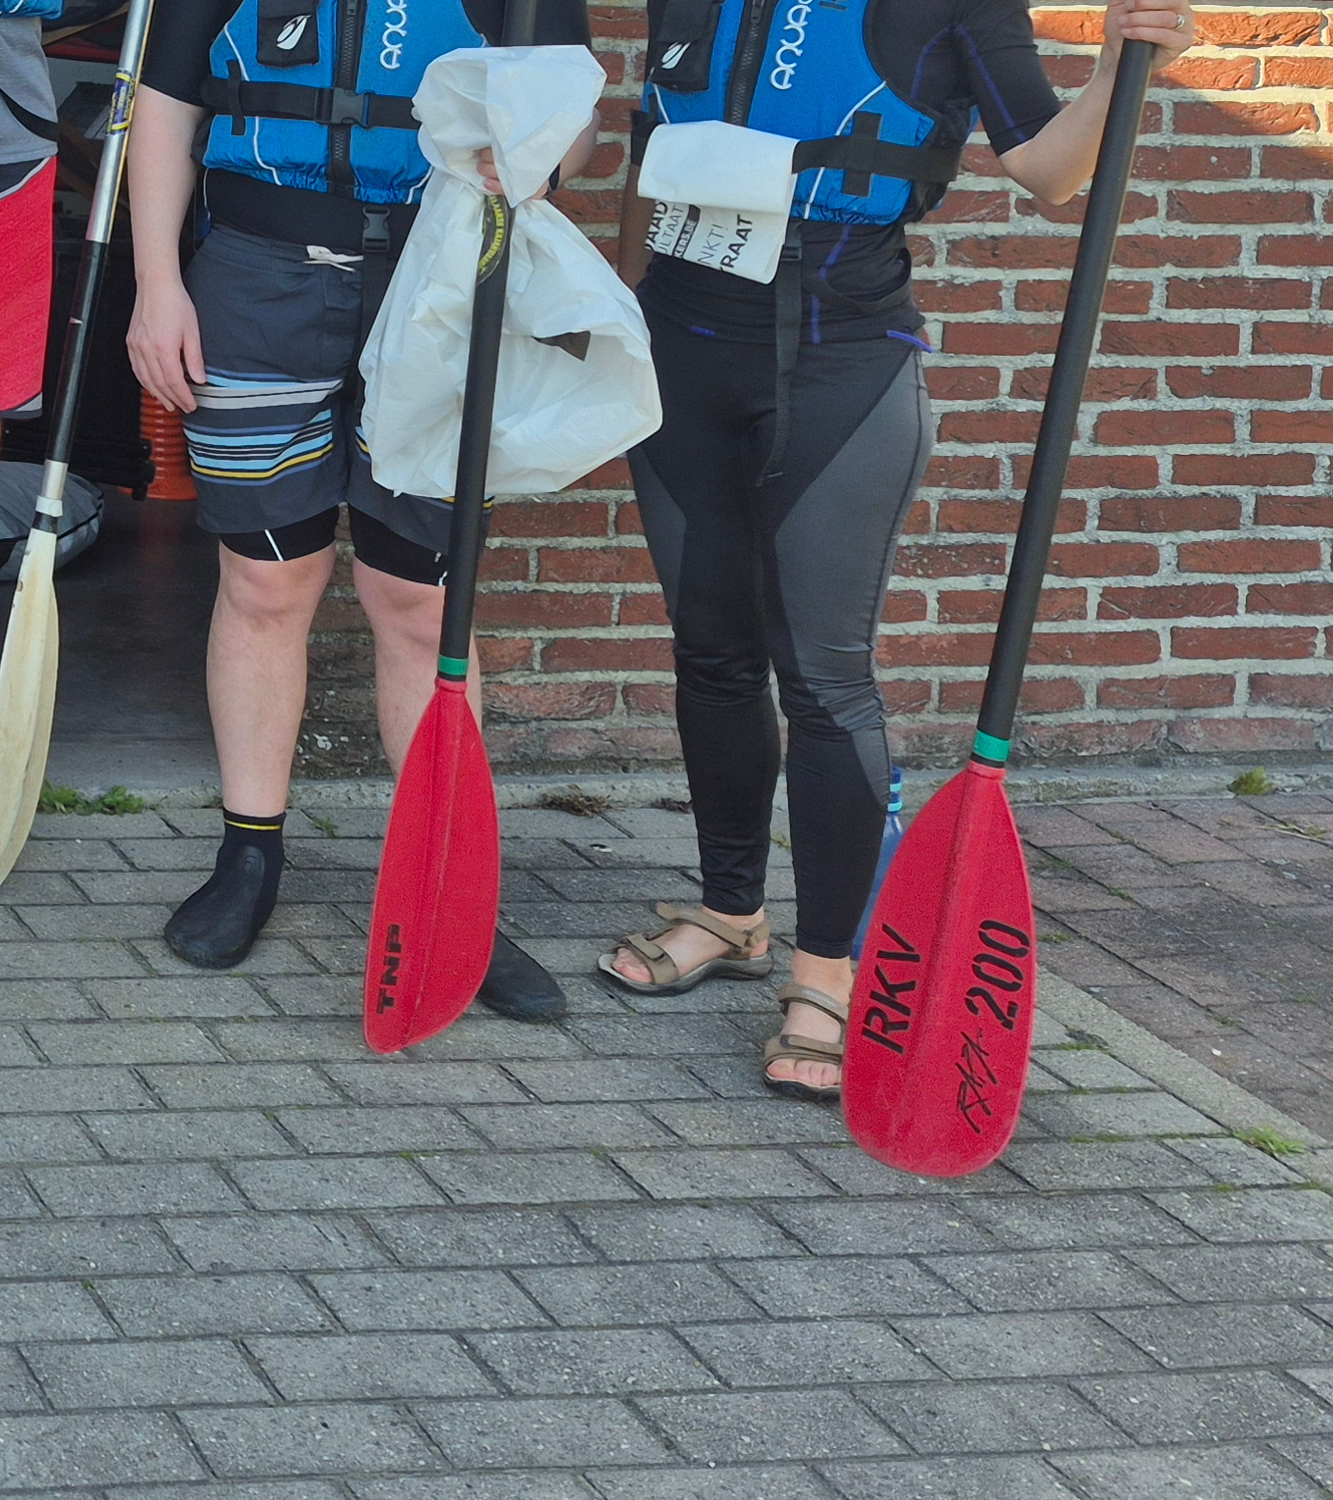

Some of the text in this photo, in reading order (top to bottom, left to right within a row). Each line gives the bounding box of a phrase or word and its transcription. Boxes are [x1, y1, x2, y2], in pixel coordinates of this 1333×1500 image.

[720, 213, 753, 272] RAAT
[376, 923, 403, 1016] TNP
[860, 923, 922, 1055] RKV
[963, 917, 1032, 1032] 200
